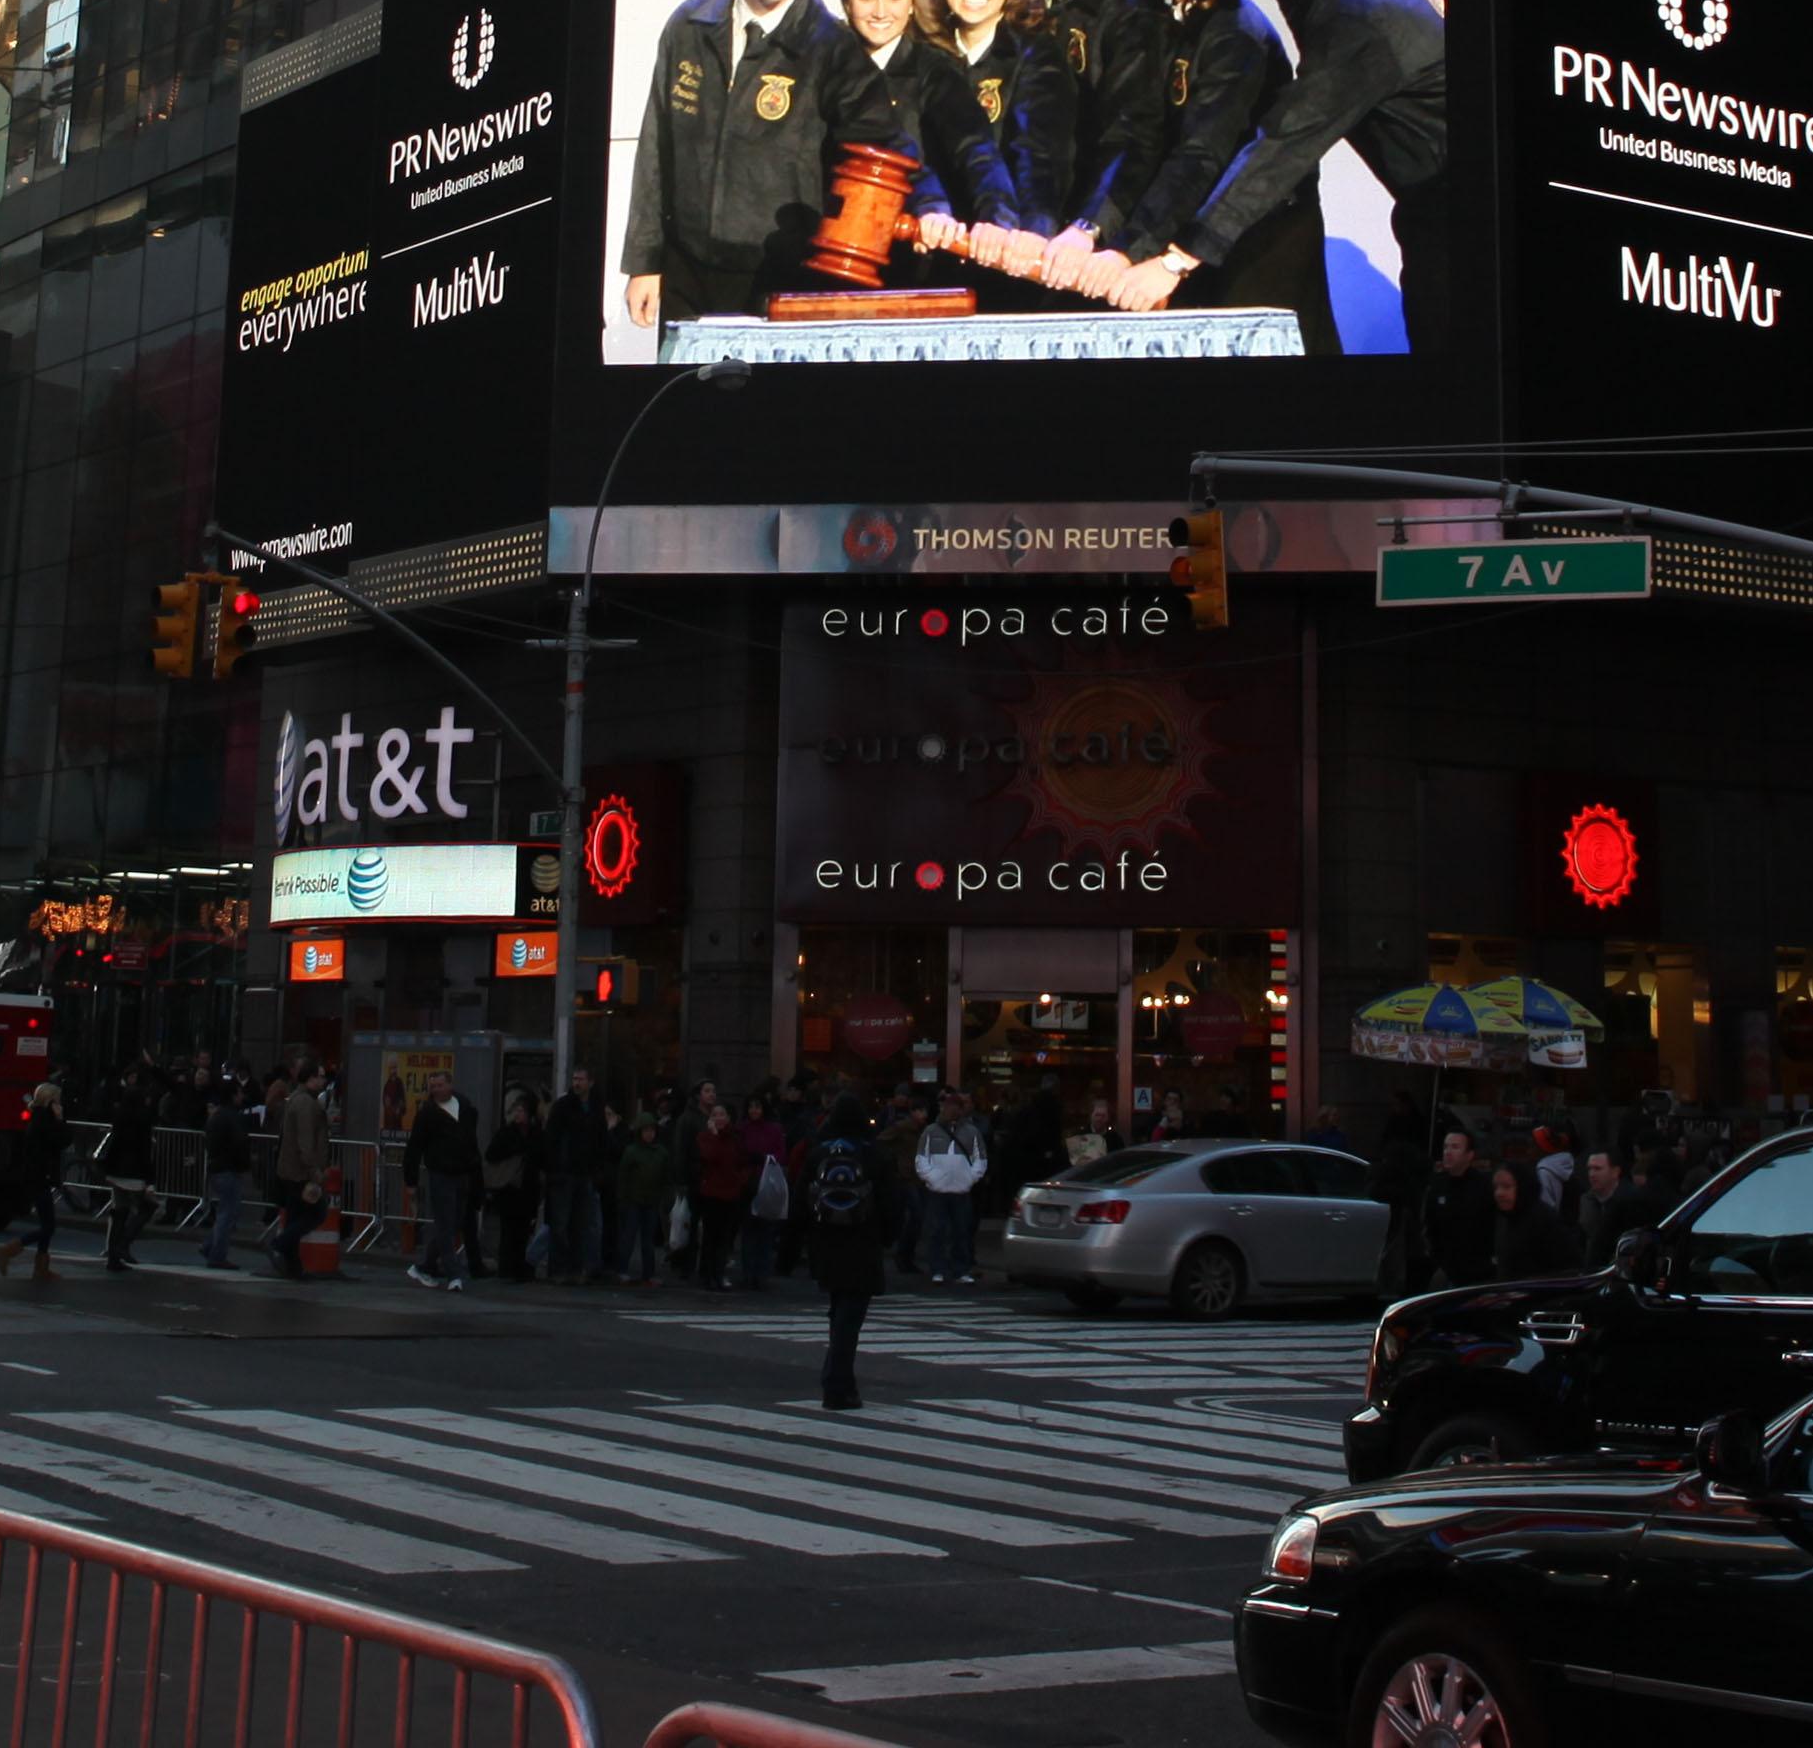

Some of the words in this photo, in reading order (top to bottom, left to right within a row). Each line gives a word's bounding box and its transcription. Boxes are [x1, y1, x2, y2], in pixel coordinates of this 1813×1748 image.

[1552, 45, 1613, 108] PR
[389, 135, 420, 184] PR
[425, 91, 552, 171] Newswire
[1599, 127, 1656, 159] United
[1660, 142, 1736, 177] Business
[1739, 158, 1791, 188] Media
[411, 182, 443, 210] United
[445, 168, 488, 198] Business
[491, 155, 524, 182] Media
[241, 272, 292, 315] engage
[913, 528, 1055, 551] THOMSON
[1064, 527, 1174, 549] REUTER
[1458, 556, 1481, 589] 7
[1501, 555, 1567, 586] Av
[1050, 595, 1171, 638] café
[297, 706, 474, 825] at&t
[295, 874, 339, 895] Possible
[1048, 849, 1169, 892] café
[1138, 1089, 1148, 1103] A
